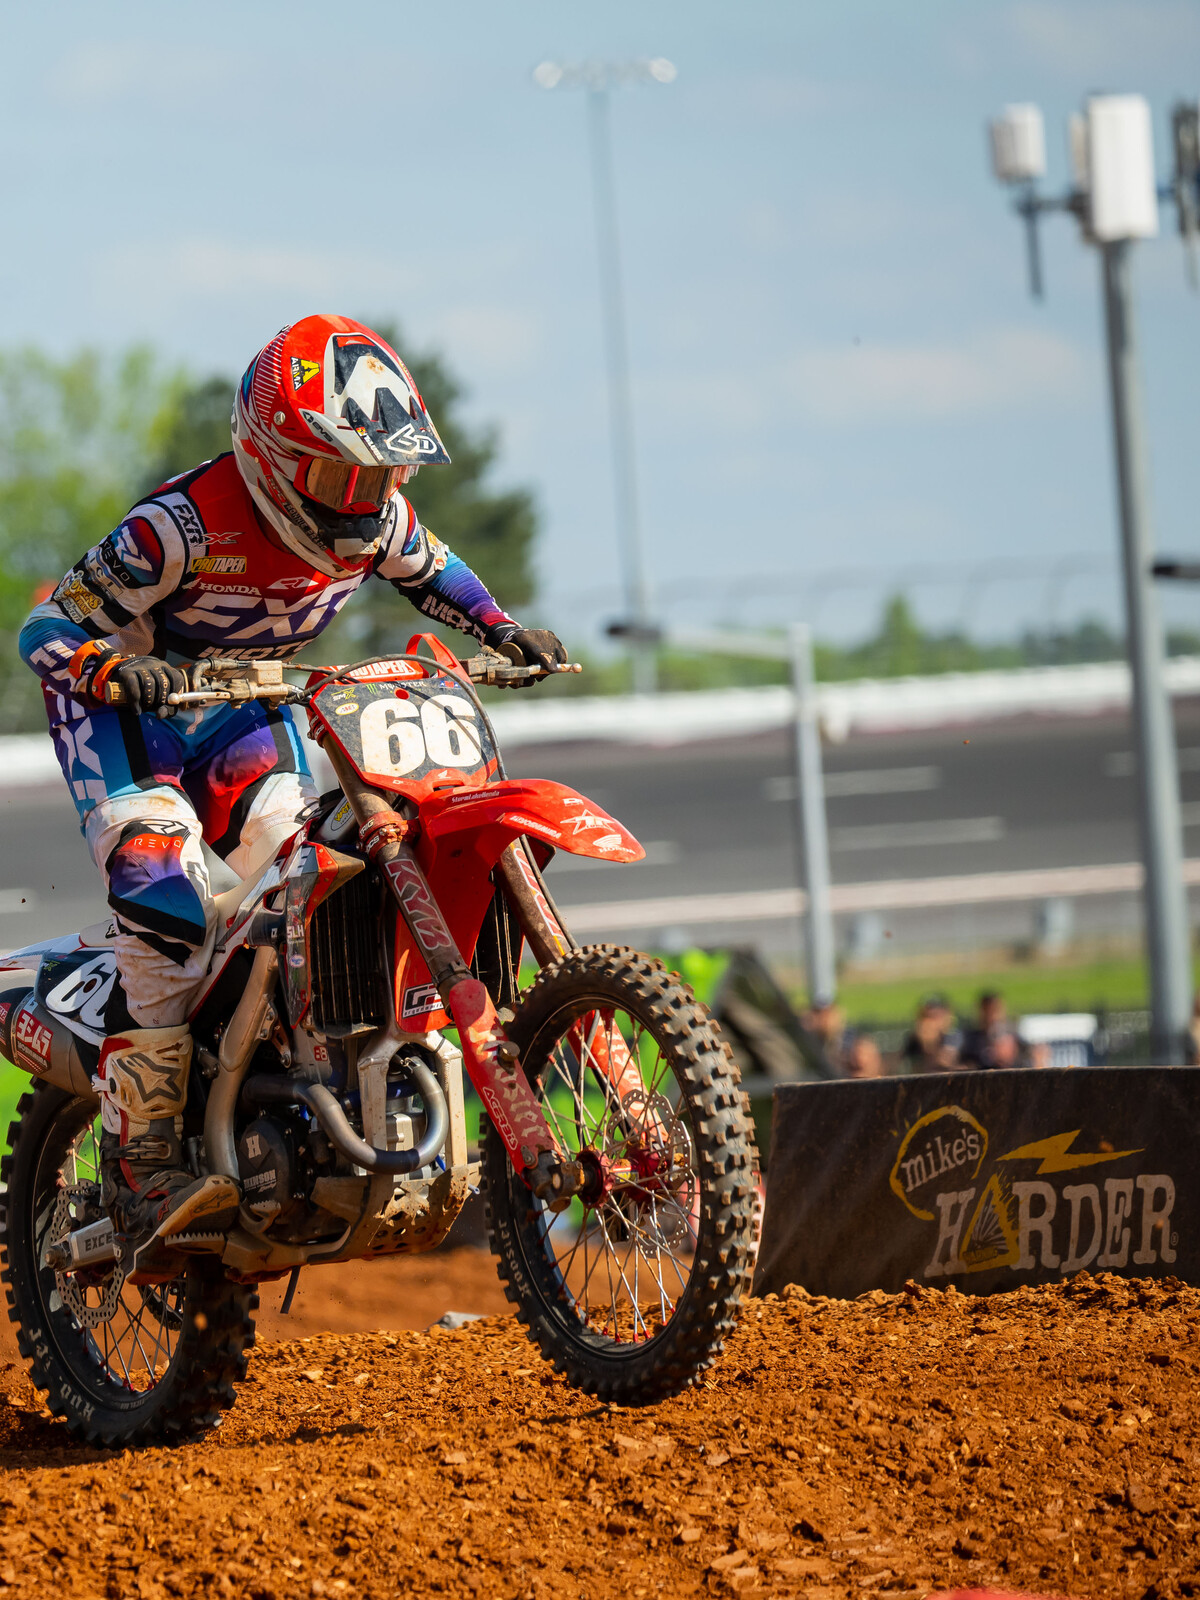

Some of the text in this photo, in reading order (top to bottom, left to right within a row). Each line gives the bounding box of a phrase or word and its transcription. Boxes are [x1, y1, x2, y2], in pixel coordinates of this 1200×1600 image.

[193, 556, 246, 574] PROTAPER
[173, 572, 366, 640] FXR
[199, 581, 261, 596] HONDA
[360, 694, 484, 777] 66
[133, 838, 182, 849] REVO
[384, 857, 452, 950] KYB
[243, 1168, 278, 1190] HINSON
[901, 1129, 980, 1192] mike's
[84, 1230, 114, 1253] EXCE
[924, 1174, 1177, 1277] HARDER
